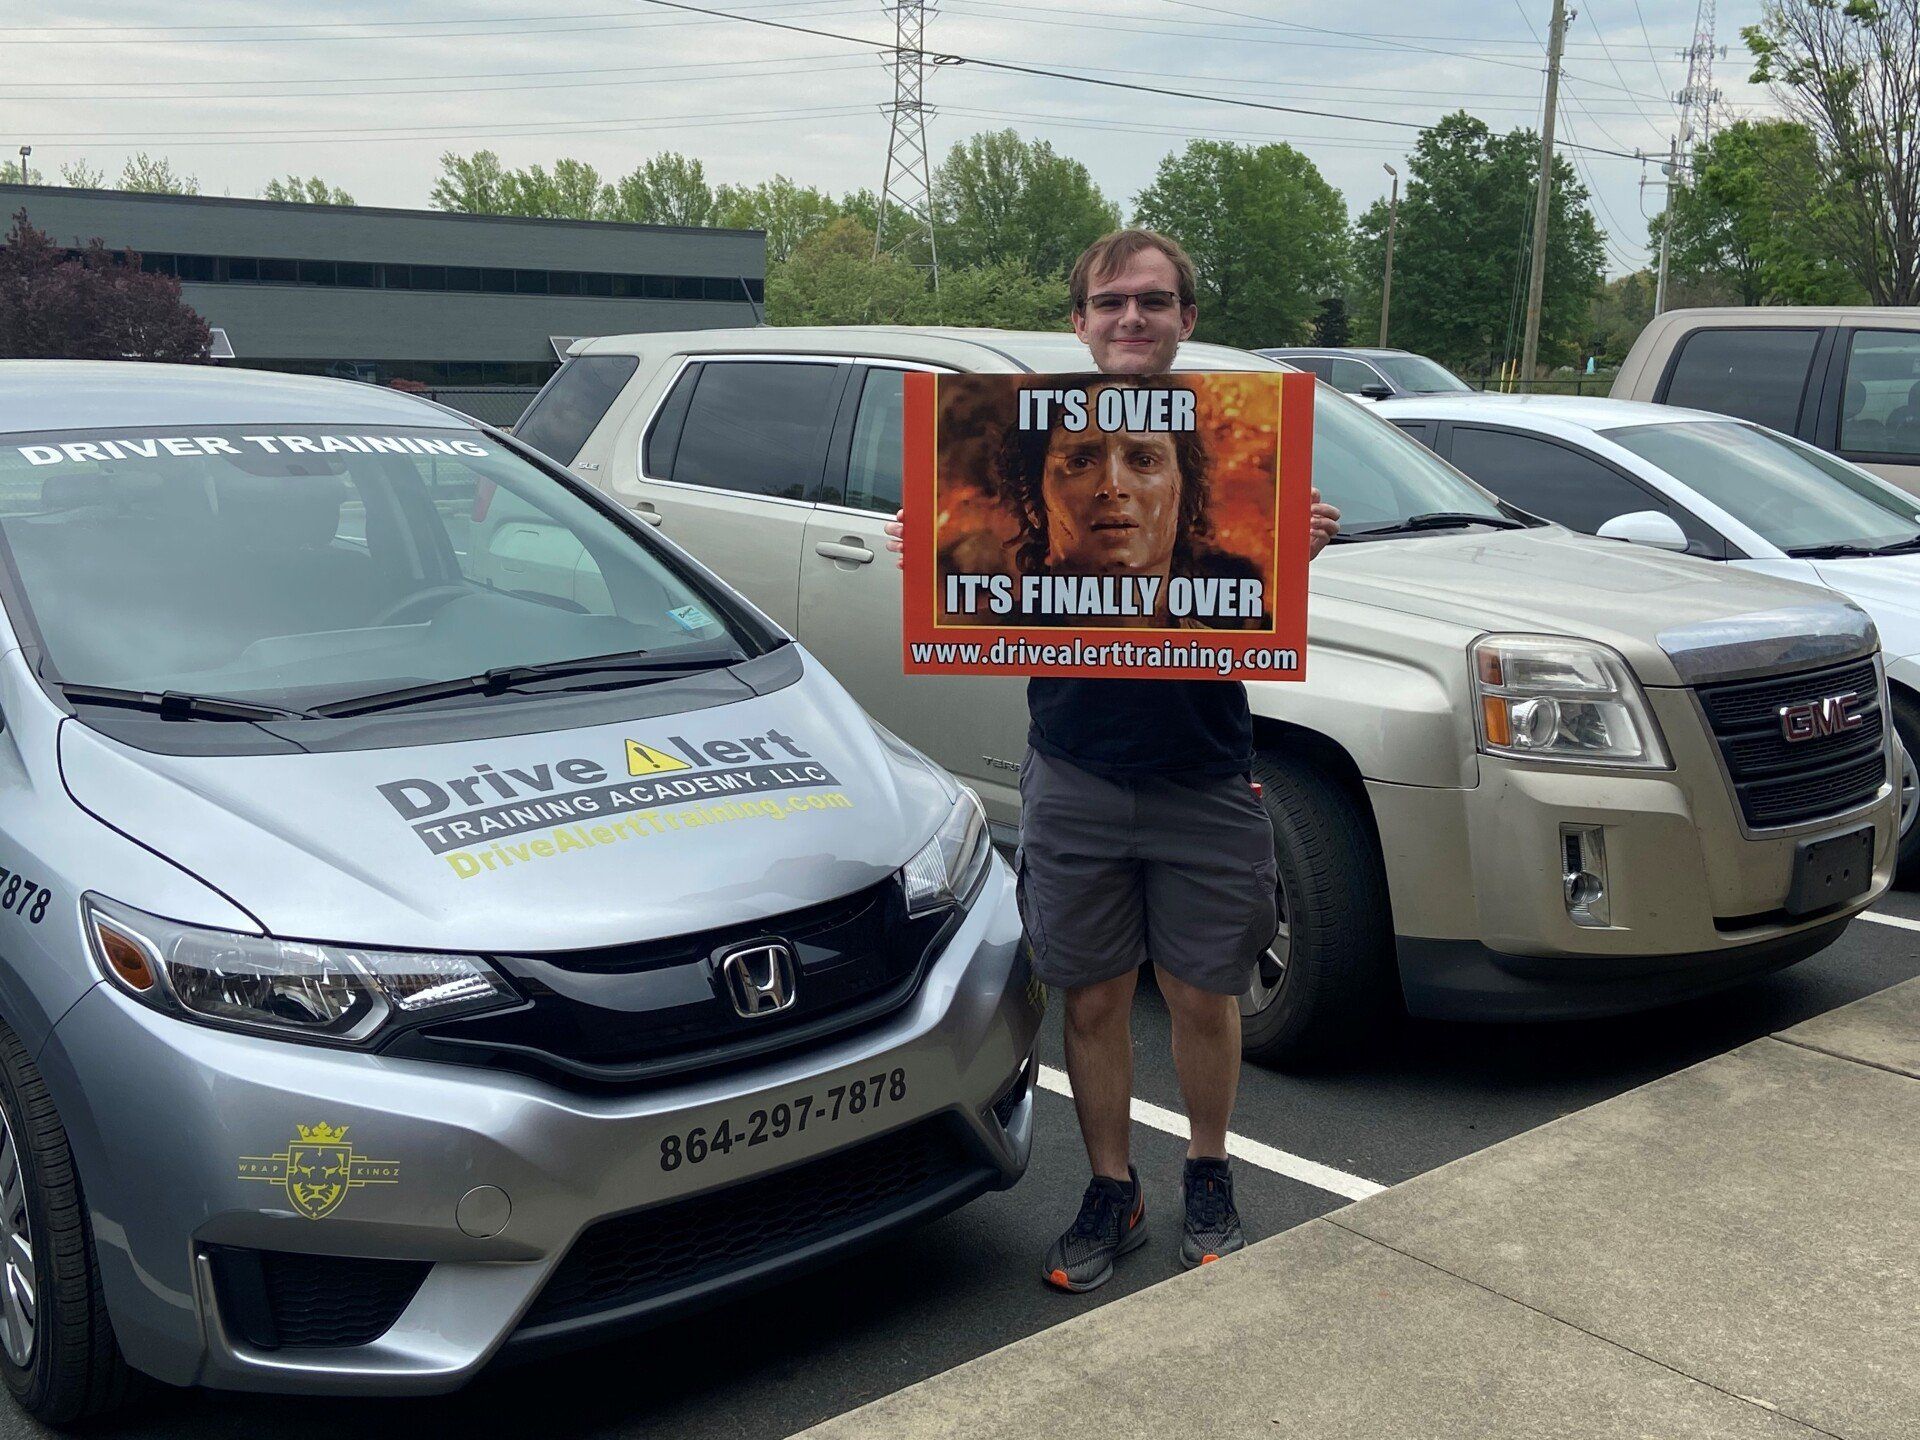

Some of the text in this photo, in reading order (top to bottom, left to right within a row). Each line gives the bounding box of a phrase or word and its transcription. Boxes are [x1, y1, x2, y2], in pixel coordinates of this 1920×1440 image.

[1018, 388, 1196, 432] IT'S OVER
[17, 435, 490, 466] DRIVER TRAINING
[945, 575, 1263, 618] IT'S FINALLY OVER
[911, 638, 1299, 675] www.drivealerttraining.com
[1780, 692, 1862, 742] GMC
[375, 757, 608, 821] Drive
[423, 795, 600, 845] TRAINING
[768, 766, 827, 784] LLC
[444, 791, 854, 880] DriveAlertTraining.com
[660, 1067, 907, 1172] 864-297-7878
[238, 1164, 399, 1176] WRAP KINGZ
